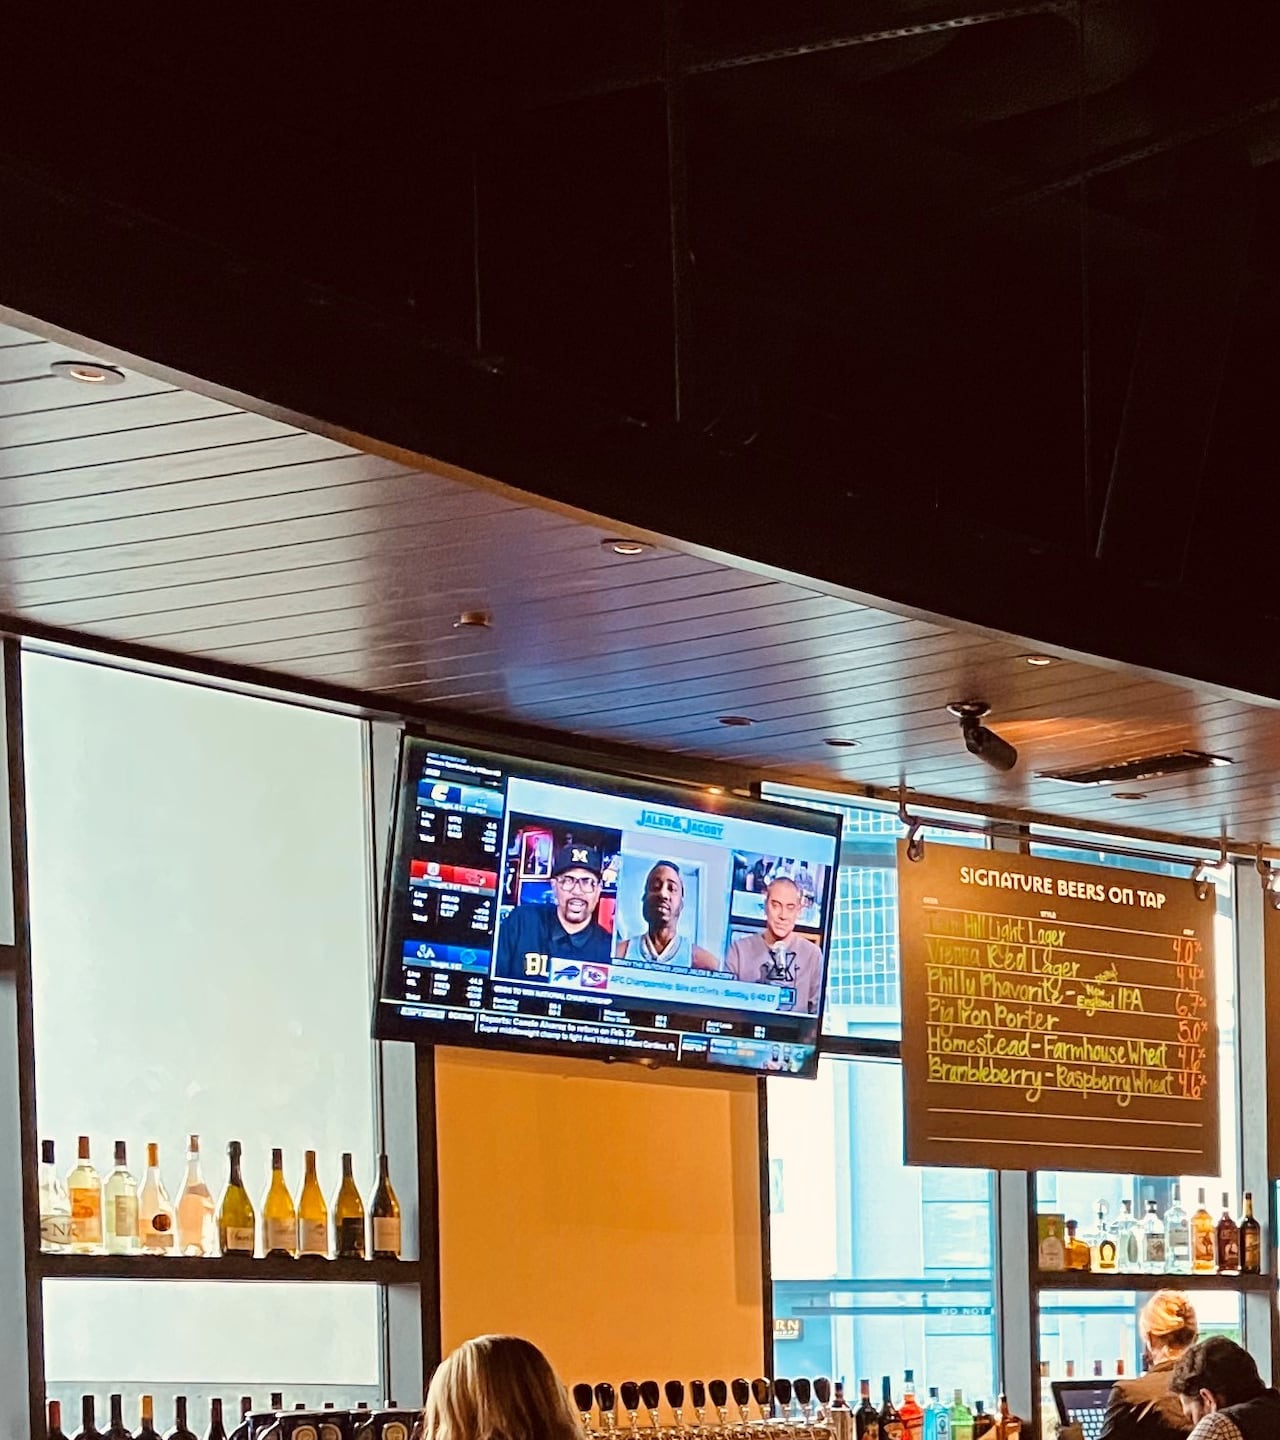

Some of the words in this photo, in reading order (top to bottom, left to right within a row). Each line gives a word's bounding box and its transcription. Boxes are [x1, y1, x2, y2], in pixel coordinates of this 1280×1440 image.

[682, 818, 724, 837] JACOBY
[571, 848, 589, 863] M
[960, 866, 1054, 895] SIGNATURE
[1057, 879, 1106, 902] BEERS
[1108, 886, 1134, 906] ON
[1137, 890, 1166, 910] TAP
[989, 914, 1025, 945] Light
[1028, 920, 1066, 962] Lager
[986, 943, 1028, 972] Red
[1031, 947, 1080, 992] Lager
[927, 967, 975, 1010] Philly
[979, 970, 1064, 1005] Phavorite
[1117, 987, 1144, 1012] IPA
[625, 1029, 636, 1038] 27
[928, 996, 954, 1037] Pig
[957, 999, 993, 1027] Iron
[994, 1002, 1060, 1031] Porter
[927, 1026, 1031, 1057] Homestead
[1044, 1035, 1127, 1064] Farmhouse
[1128, 1040, 1168, 1069] Wheat
[928, 1054, 1042, 1103] Brambleberry
[1056, 1063, 1131, 1107] Raspberry
[1131, 1068, 1175, 1095] Wheat
